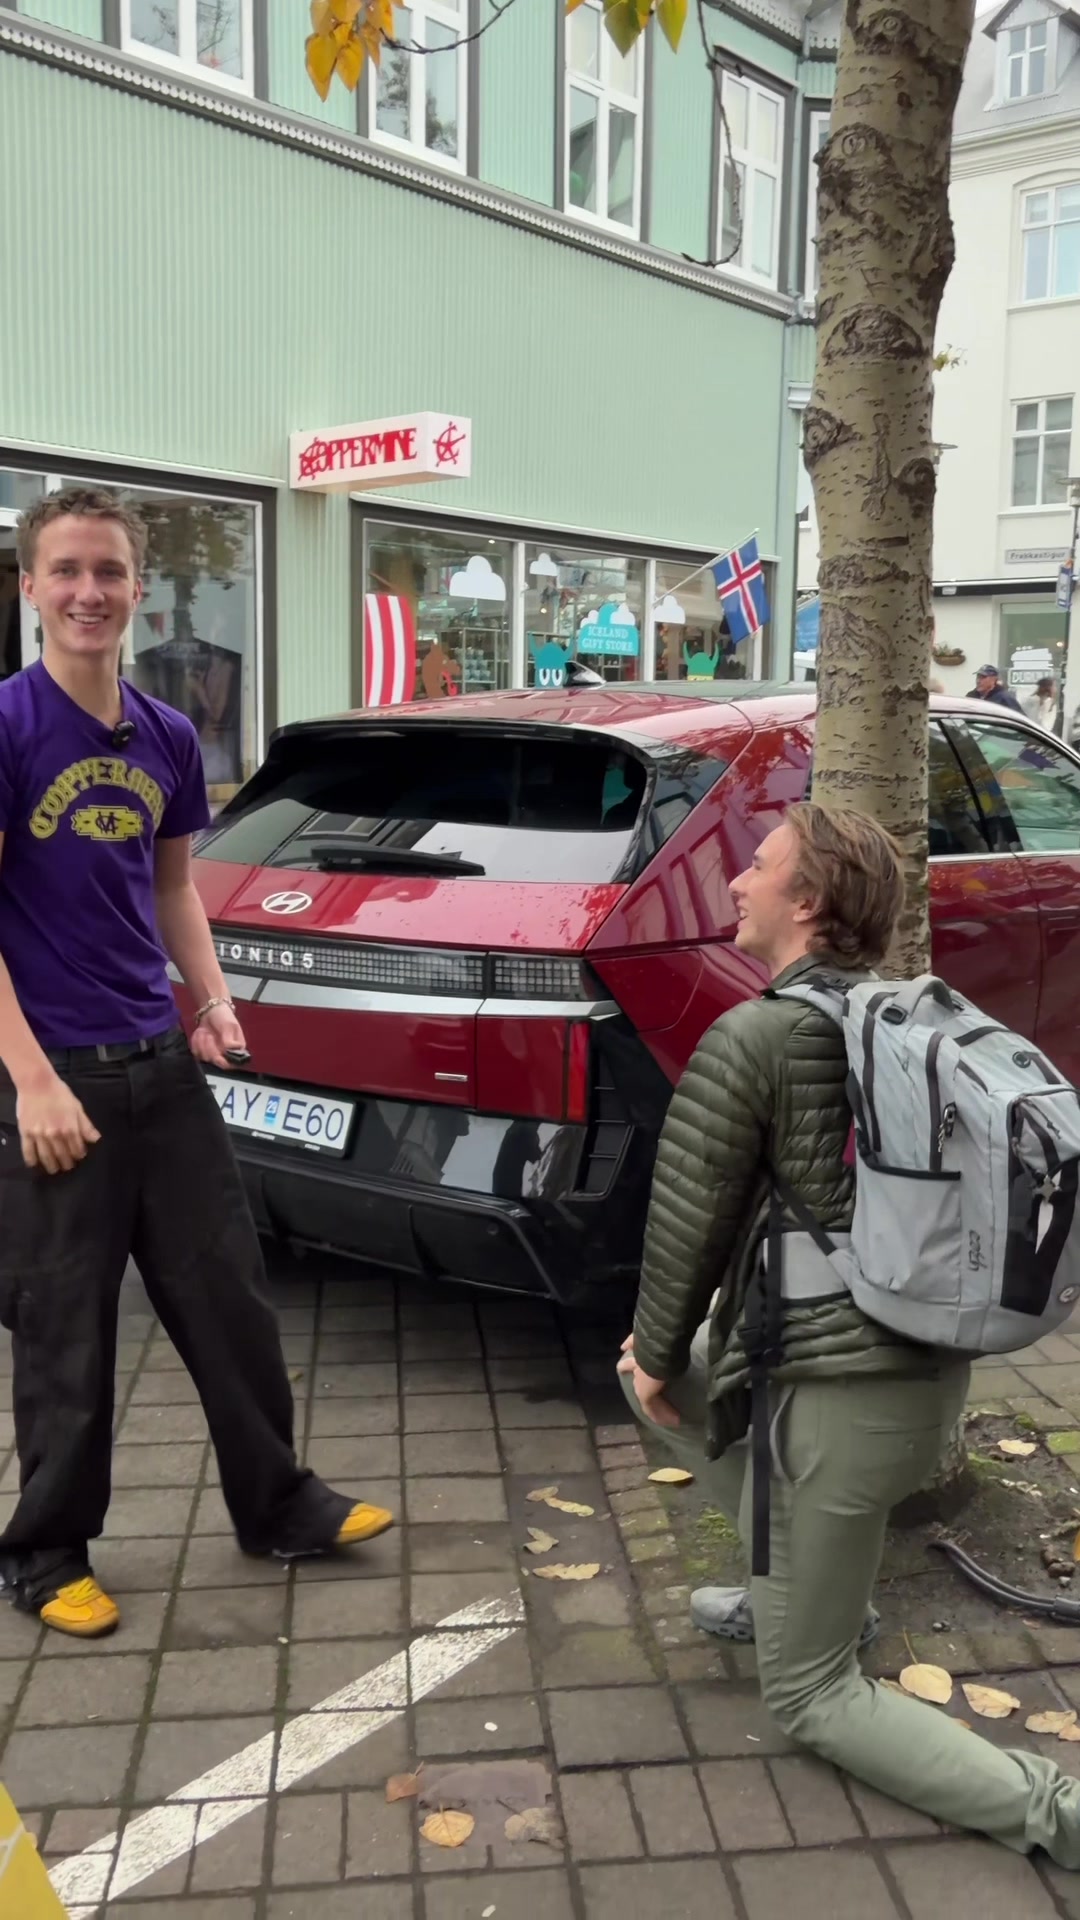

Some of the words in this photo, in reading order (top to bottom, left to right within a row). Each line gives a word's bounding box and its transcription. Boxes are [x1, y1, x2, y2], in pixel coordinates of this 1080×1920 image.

[298, 427, 418, 481] COPPERMINE
[582, 638, 603, 649] GIFT
[605, 640, 633, 651] STORE
[588, 626, 628, 638] ICELAND
[220, 943, 294, 966] IONIQ
[303, 952, 313, 969] 5
[282, 1098, 344, 1141] E60
